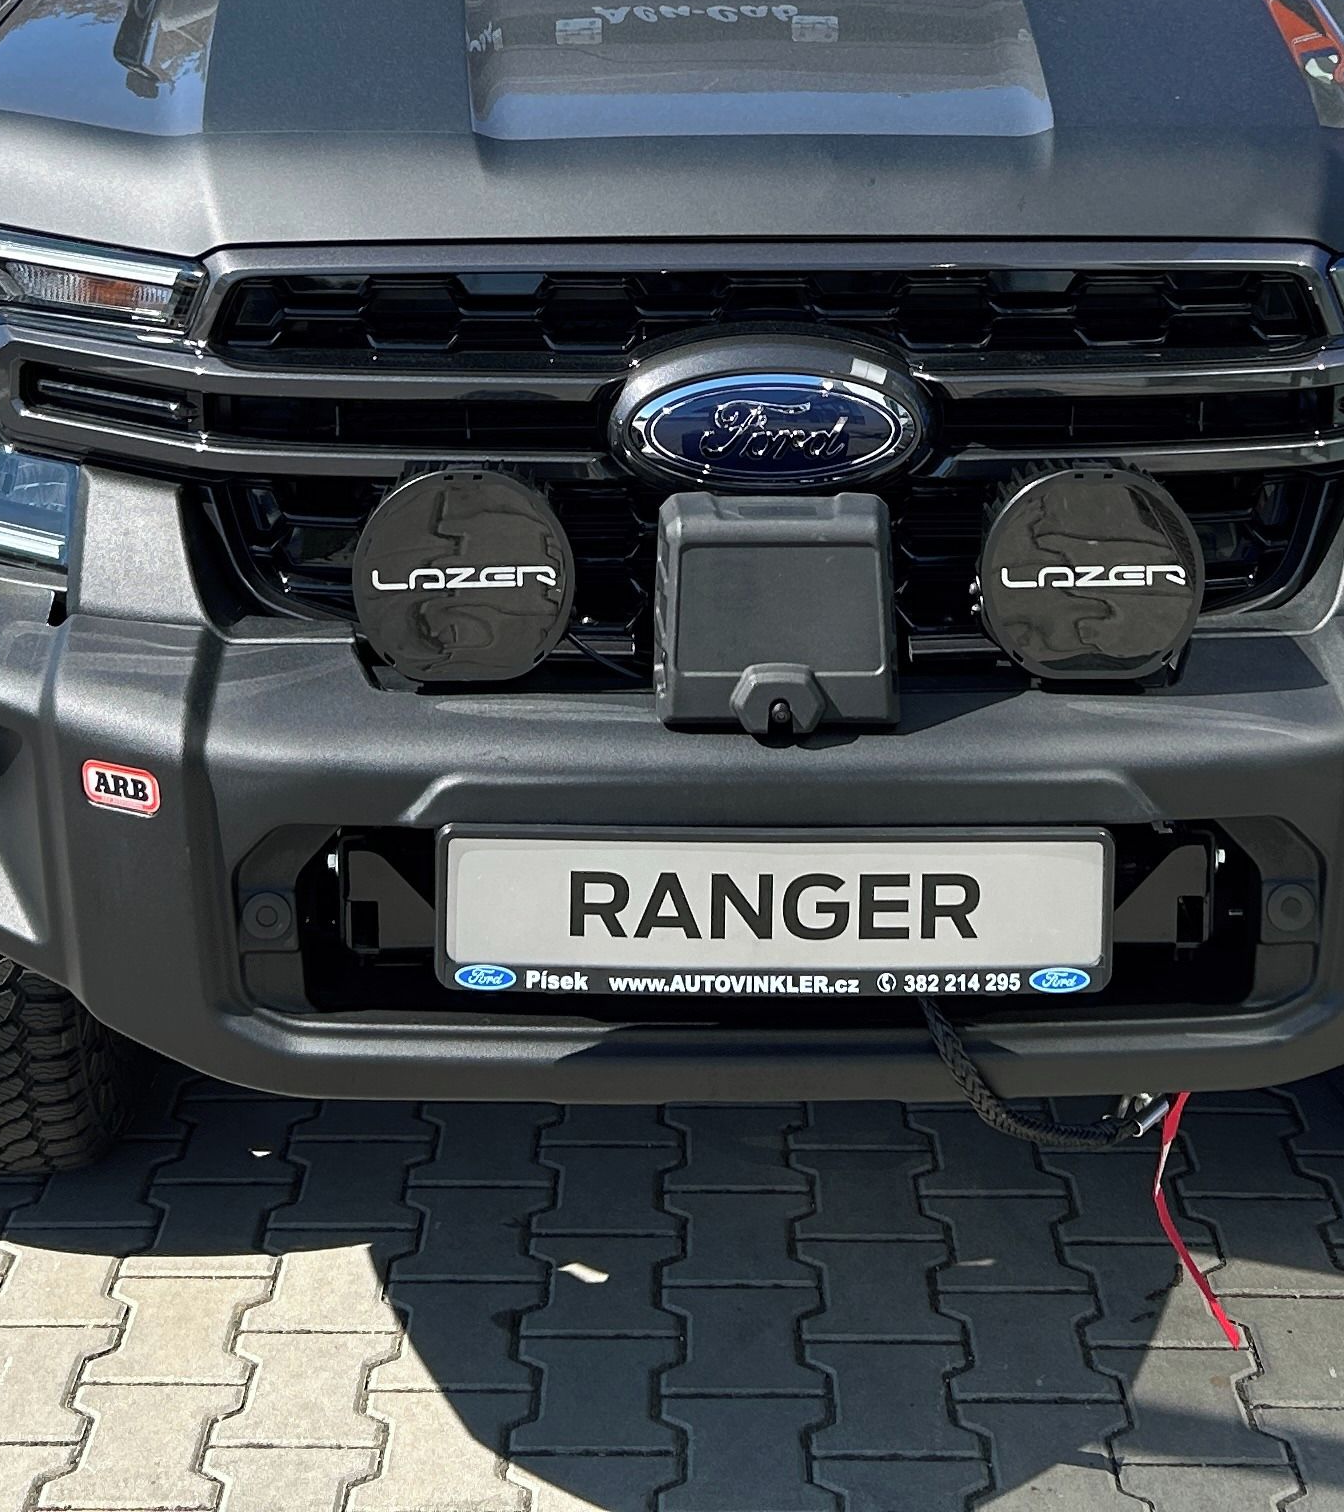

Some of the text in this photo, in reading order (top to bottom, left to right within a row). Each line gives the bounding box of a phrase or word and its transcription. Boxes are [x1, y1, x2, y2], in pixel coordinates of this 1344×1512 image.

[699, 399, 849, 461] Ford
[371, 566, 557, 591] LAZER
[1001, 565, 1186, 589] LAZER
[94, 770, 150, 802] ARB
[569, 870, 981, 940] RANGER
[468, 968, 505, 985] Ford
[525, 969, 1021, 994] Písek www.AUTOVINKLER.cz 382 214 295
[1041, 972, 1078, 988] Ford
